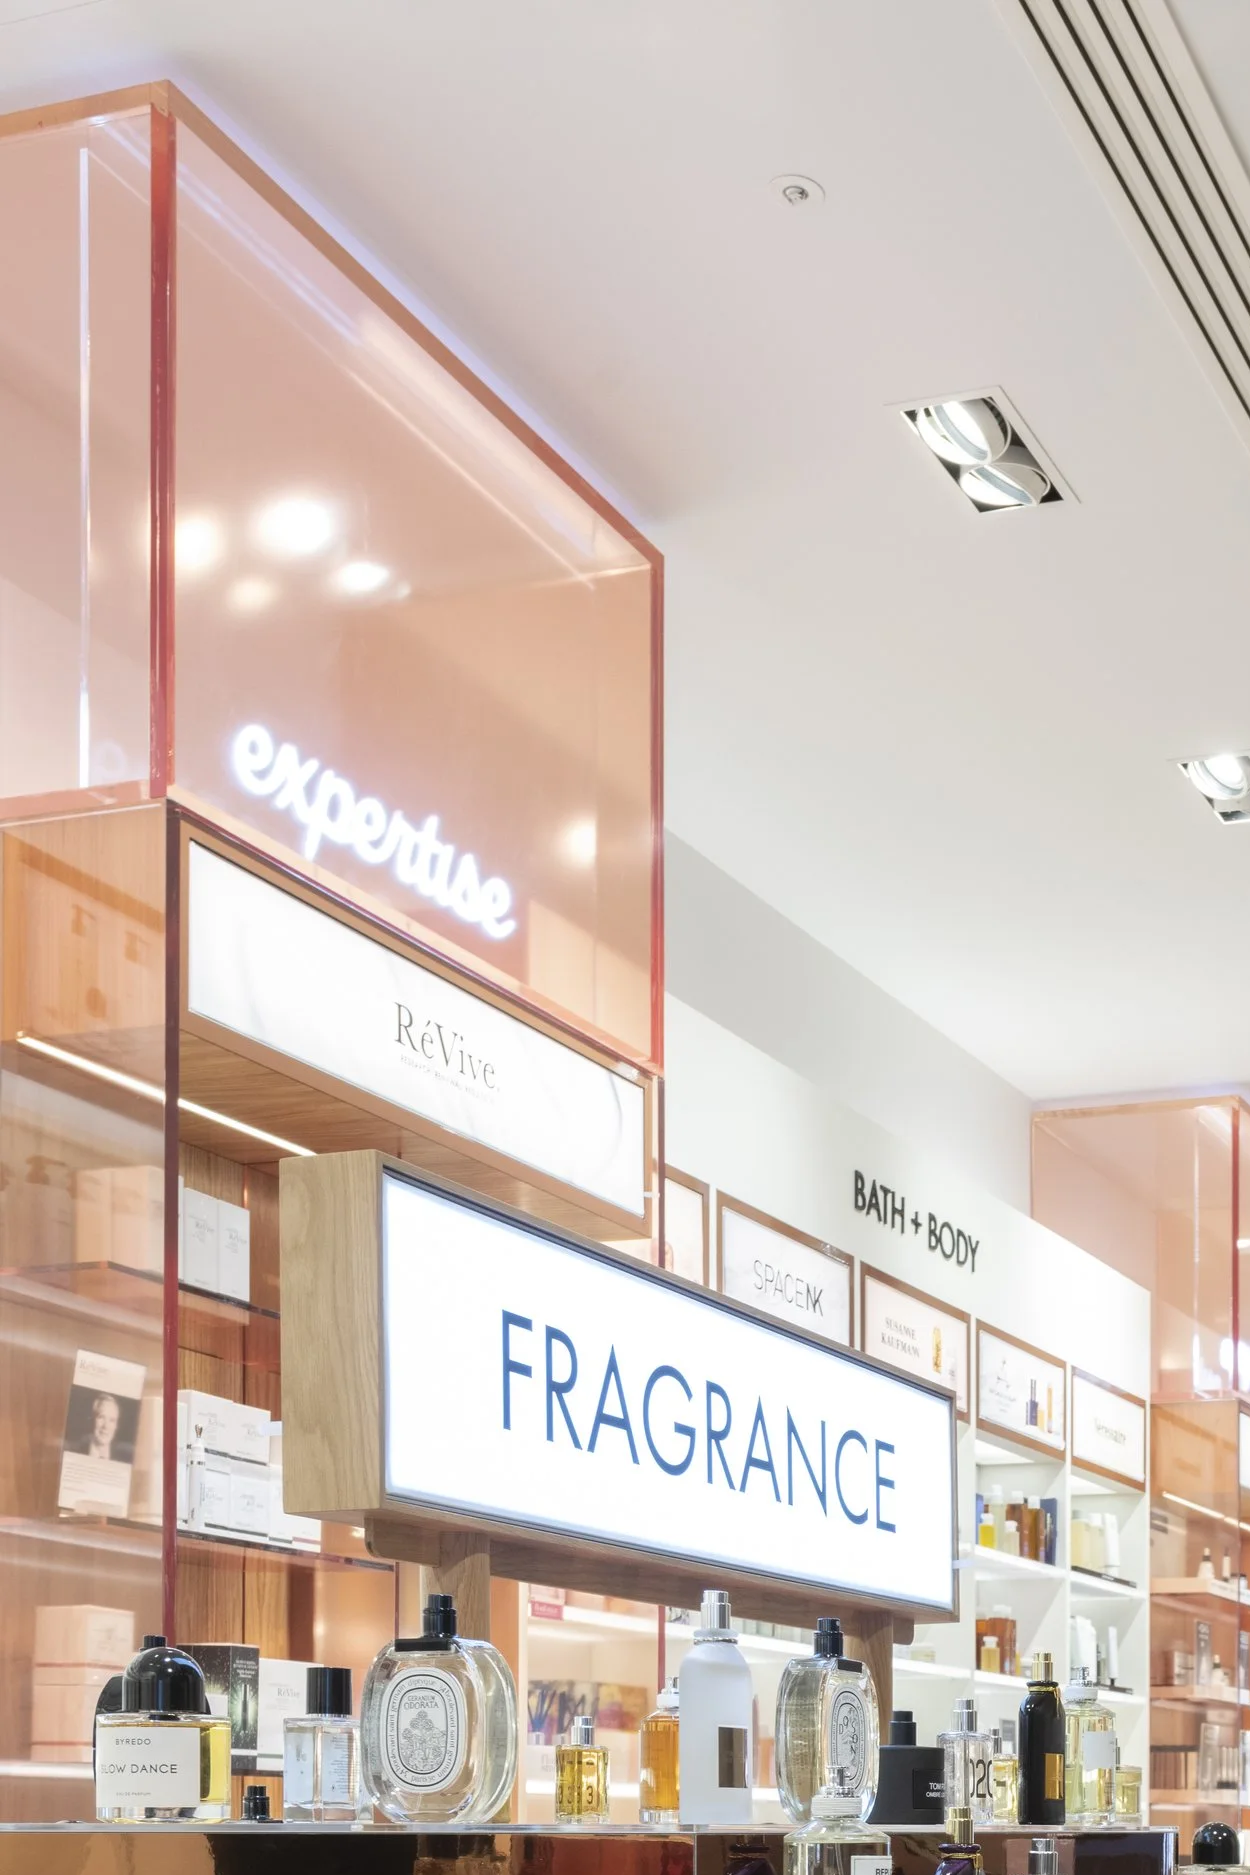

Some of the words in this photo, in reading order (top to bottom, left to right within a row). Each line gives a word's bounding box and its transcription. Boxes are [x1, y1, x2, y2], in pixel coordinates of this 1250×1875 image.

[231, 722, 518, 940] expertise
[393, 1001, 496, 1090] RéVive
[853, 1168, 906, 1236] BATH
[927, 1211, 980, 1274] BODY
[884, 1316, 916, 1341] SUSANNE
[501, 1308, 897, 1534] FRAGRANCE
[403, 1701, 440, 1711] ODORATA
[115, 1738, 152, 1746] BYREDO
[130, 1763, 178, 1774] DANCE
